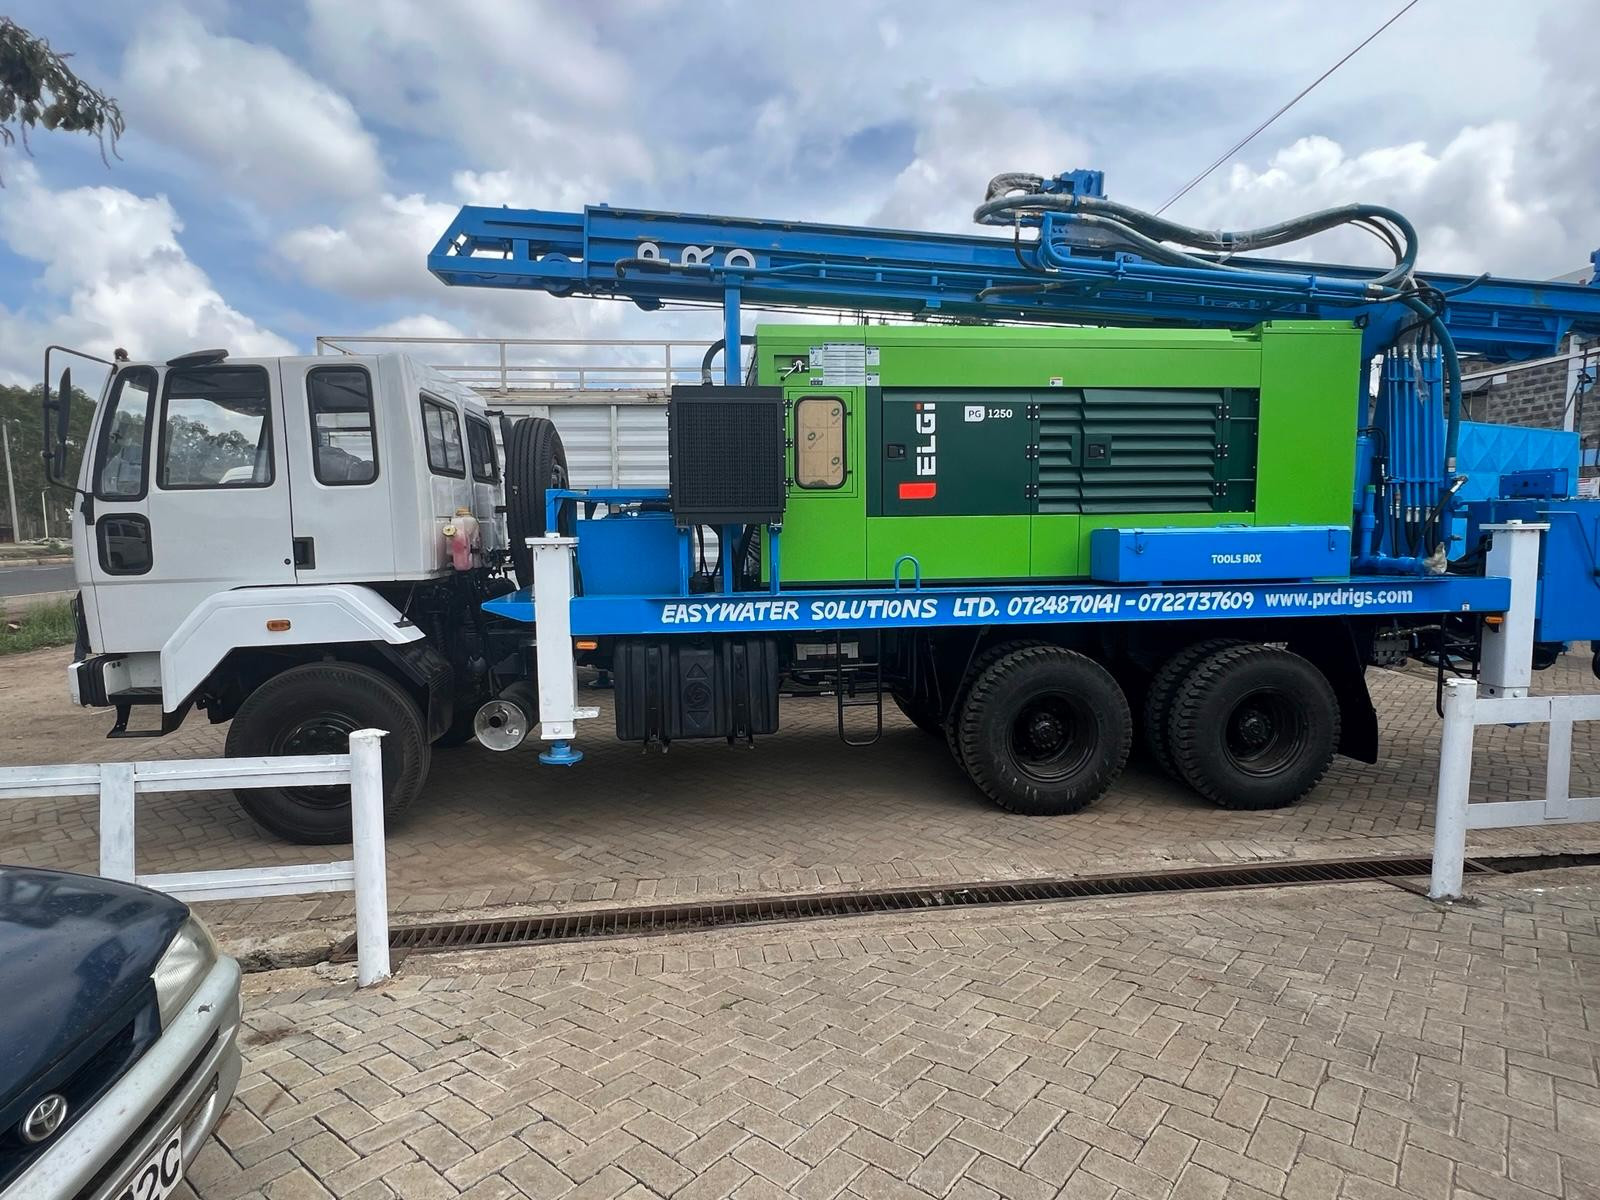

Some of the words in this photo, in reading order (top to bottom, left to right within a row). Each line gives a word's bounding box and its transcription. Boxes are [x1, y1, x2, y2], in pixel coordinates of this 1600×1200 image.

[967, 409, 982, 419] PG
[987, 408, 1013, 419] 1250
[1211, 554, 1241, 565] TOOLS
[1243, 553, 1262, 564] BOX
[660, 600, 801, 625] EASYWATER
[810, 597, 938, 622] SOLUTIONS
[953, 595, 1000, 618] LTD.
[1263, 588, 1414, 610] www.prdrigs.com
